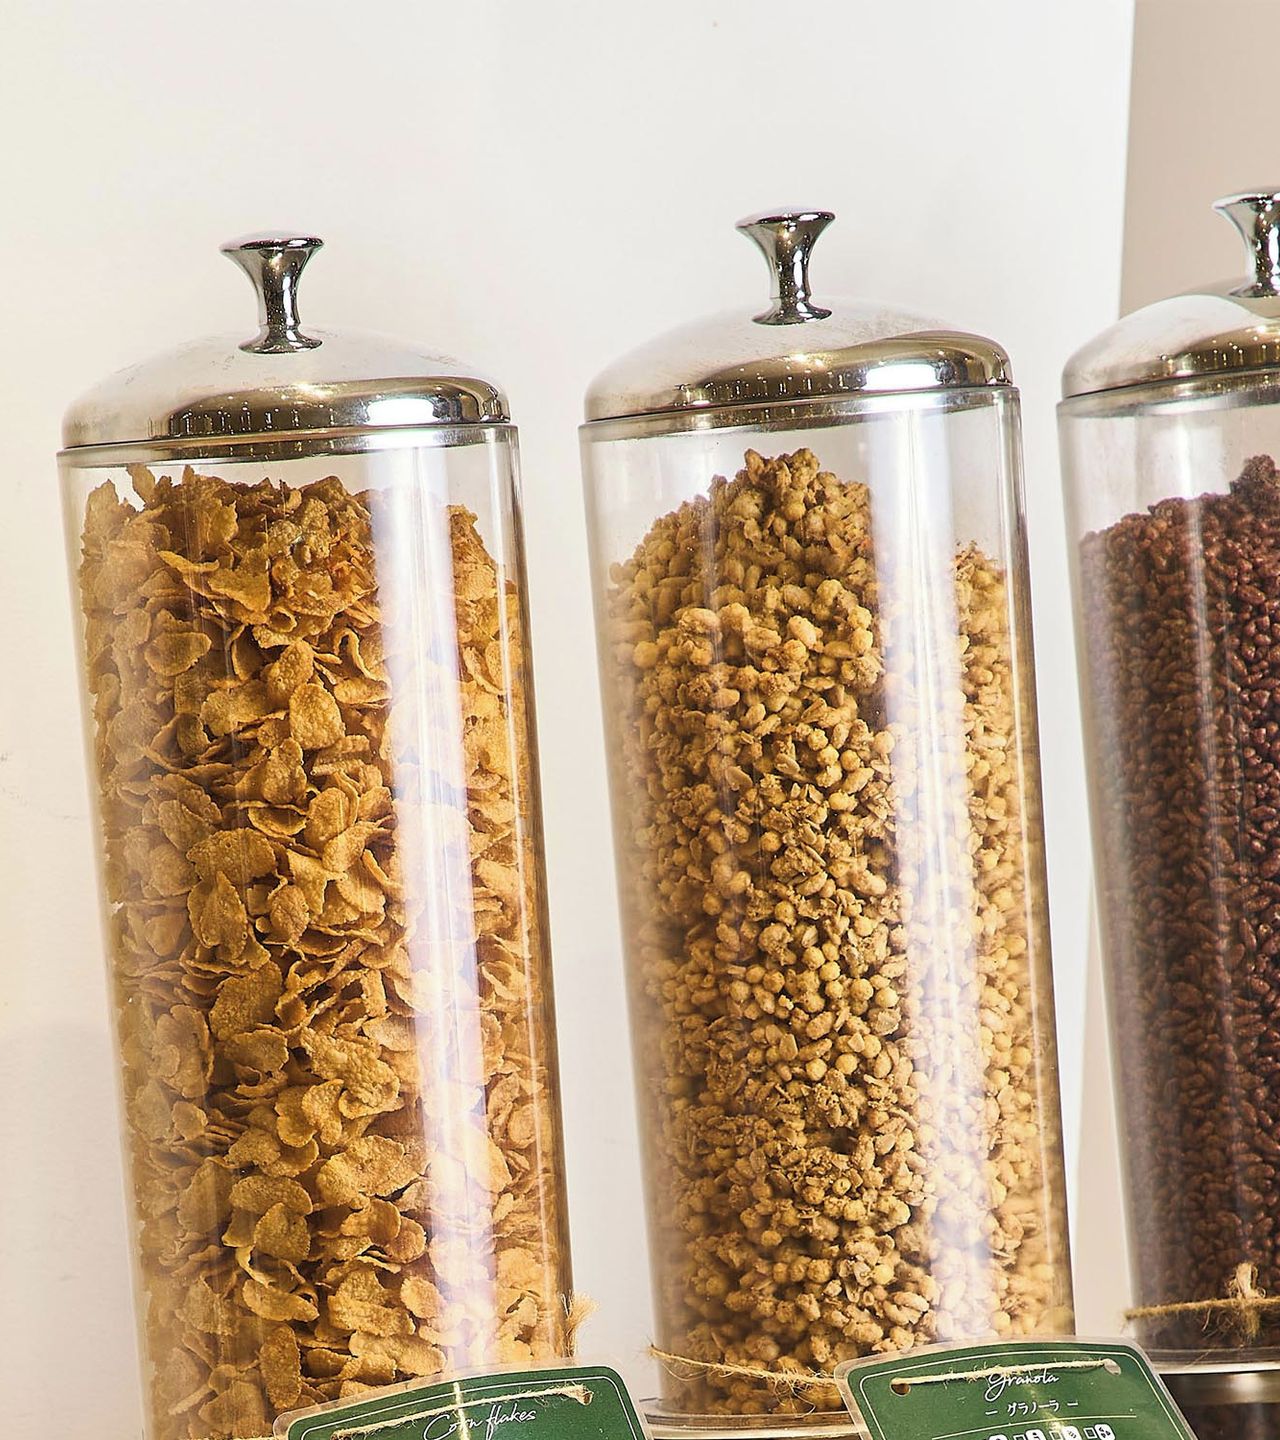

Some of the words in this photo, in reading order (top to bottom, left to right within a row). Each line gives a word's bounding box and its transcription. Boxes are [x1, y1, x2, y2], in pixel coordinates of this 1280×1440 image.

[1007, 1399, 1060, 1417] グラノーラ
